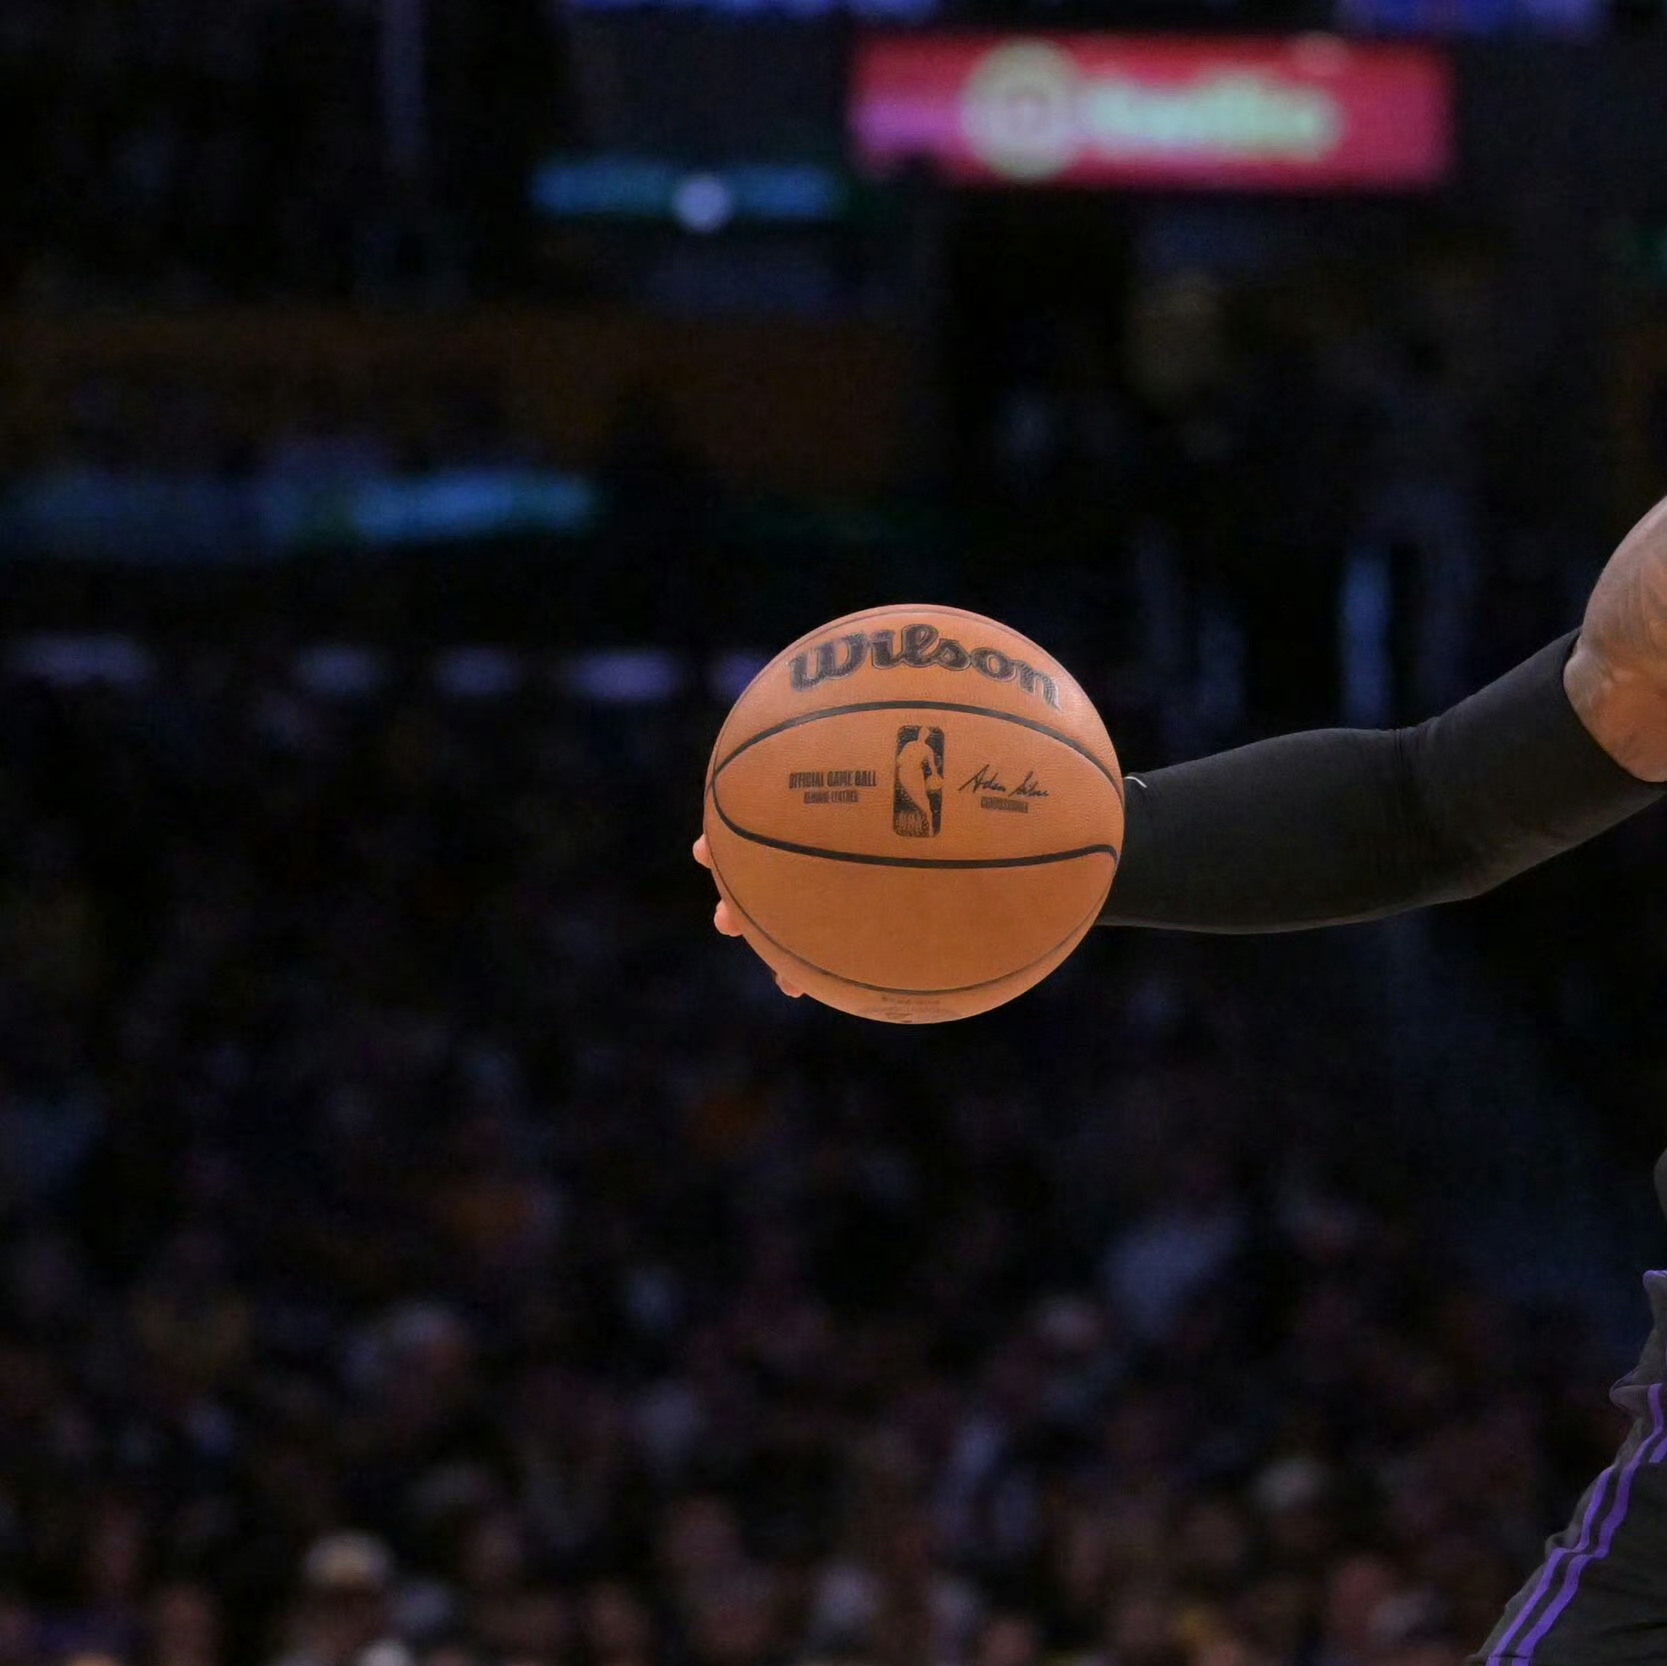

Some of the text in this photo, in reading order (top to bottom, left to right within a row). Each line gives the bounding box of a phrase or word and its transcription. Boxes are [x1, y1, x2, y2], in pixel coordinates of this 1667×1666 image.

[788, 623, 1061, 710] Wilson
[827, 770, 852, 787] GAME
[854, 770, 877, 787] BALL
